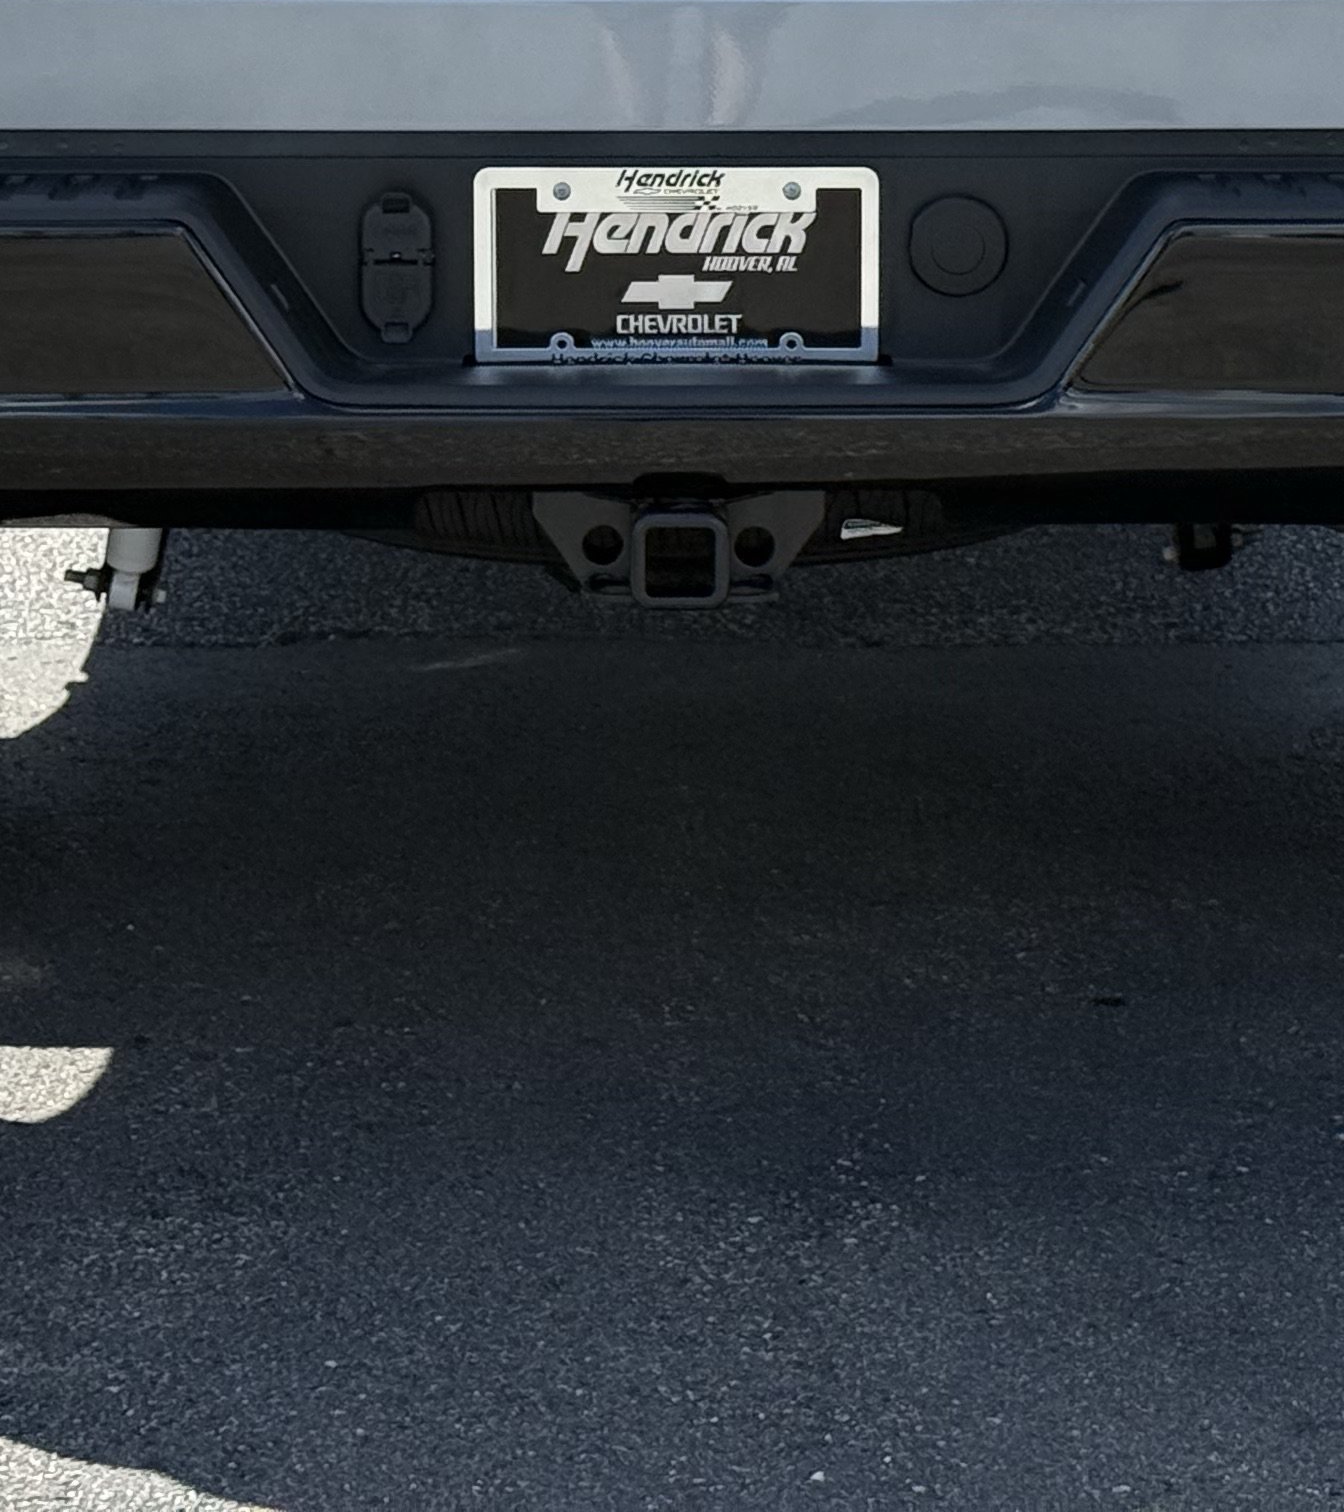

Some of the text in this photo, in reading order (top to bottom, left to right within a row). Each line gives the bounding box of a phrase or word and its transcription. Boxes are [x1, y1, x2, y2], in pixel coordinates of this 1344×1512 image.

[615, 169, 726, 193] Hendrick
[541, 212, 817, 272] Hendrick
[702, 255, 798, 274] HOOVER, AL
[616, 314, 742, 335] CHEVROLET
